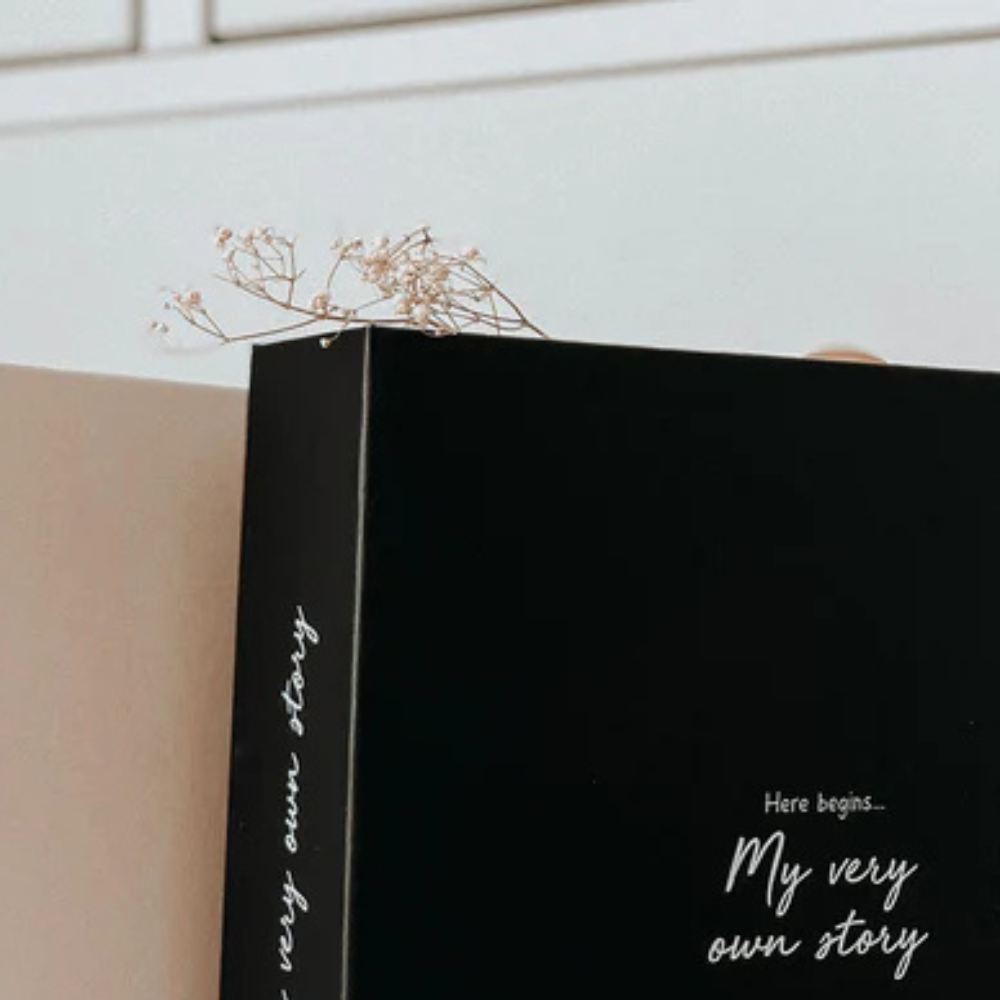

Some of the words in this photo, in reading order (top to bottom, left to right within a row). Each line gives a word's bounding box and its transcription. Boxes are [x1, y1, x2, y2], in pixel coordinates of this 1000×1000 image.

[280, 605, 320, 737] story
[285, 751, 300, 855] own
[764, 791, 810, 814] Here
[278, 869, 309, 973] very
[725, 830, 813, 918] My
[828, 855, 919, 912] very
[708, 934, 802, 964] own
[814, 909, 929, 980] story
